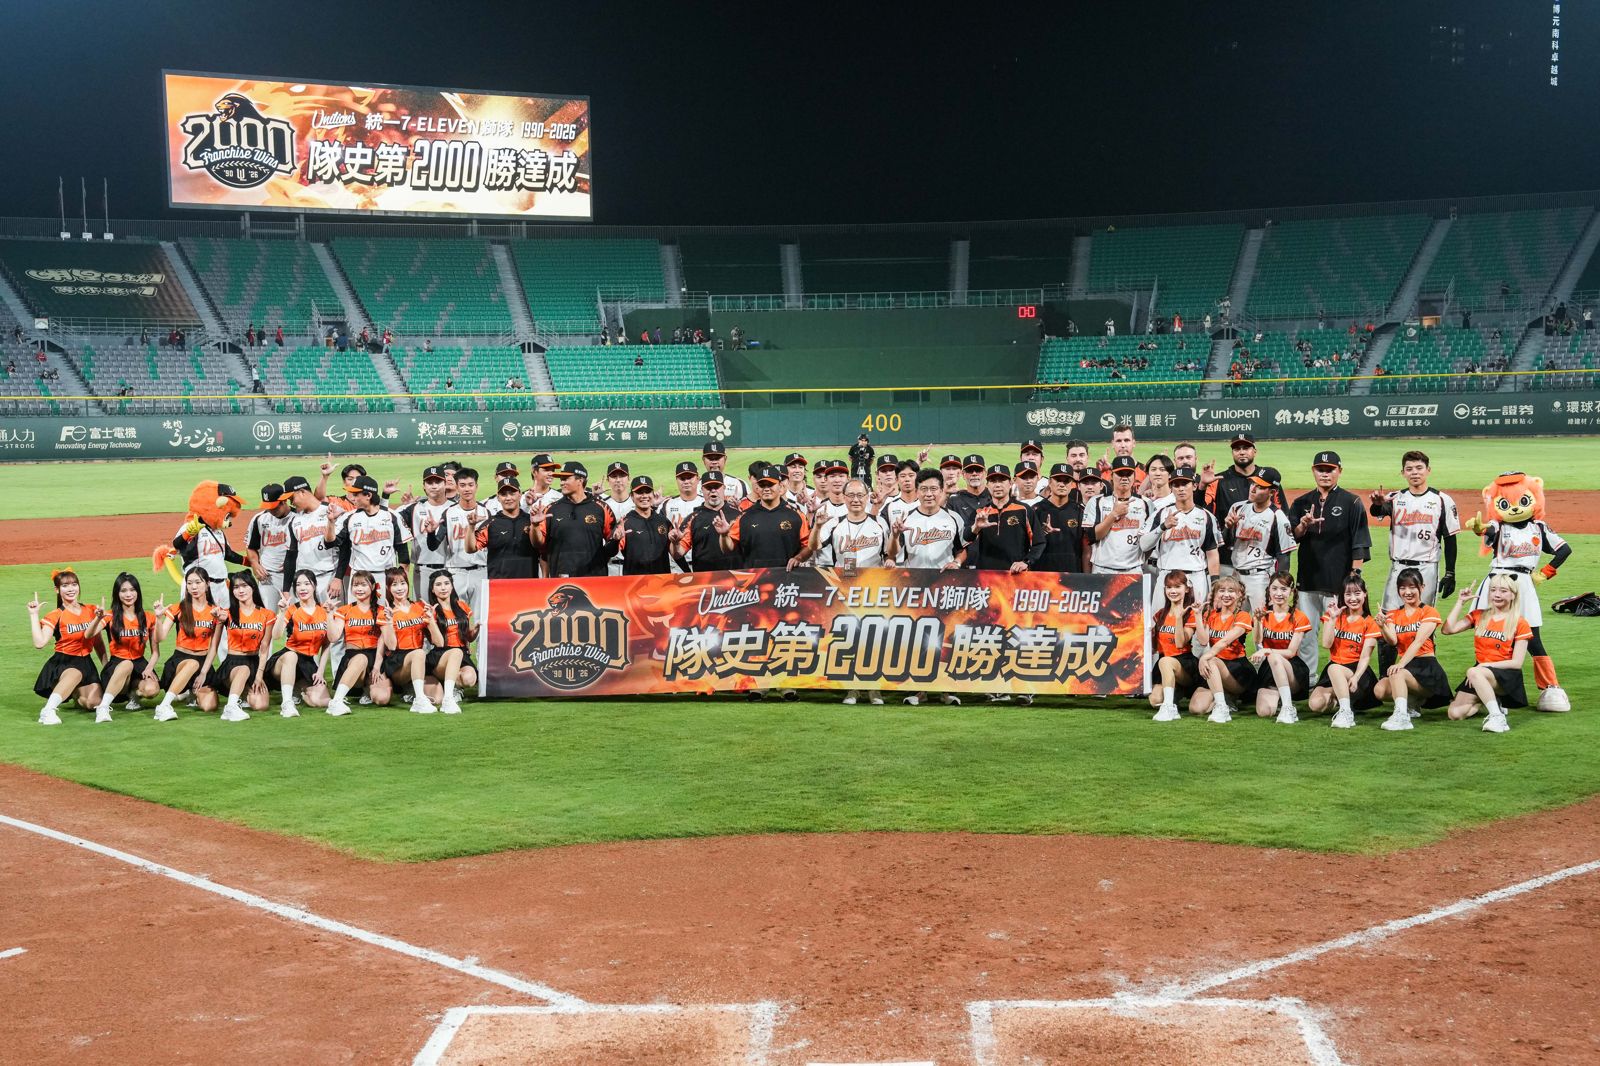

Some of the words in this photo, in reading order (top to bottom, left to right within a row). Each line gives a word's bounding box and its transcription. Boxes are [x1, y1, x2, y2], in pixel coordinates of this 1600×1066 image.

[521, 121, 577, 140] 1990-2026
[182, 115, 296, 173] 2000
[200, 147, 252, 165] Franchise
[253, 150, 279, 168] Wins
[309, 139, 579, 190] 隊史第2000勝達成
[1211, 407, 1260, 419] uniopen
[1472, 405, 1534, 416] 統一證券
[608, 420, 648, 429] KENDA
[861, 413, 902, 432] 400
[1121, 414, 1176, 427] 兆豐銀行
[90, 427, 137, 439] 富士電機
[278, 421, 302, 434] 輝葉
[351, 427, 398, 440] 全球人壽
[522, 425, 571, 437] 金門酒廠
[1198, 423, 1251, 432] 生活由我OPEN
[589, 432, 648, 441] 建大輪胎
[55, 442, 86, 450] Innovating
[88, 442, 108, 450] Energy
[110, 441, 142, 449] Technology
[1127, 535, 1138, 546] 82
[1417, 530, 1430, 541] 65
[380, 546, 391, 556] 67
[1248, 546, 1261, 558] 73
[697, 585, 761, 615] Unilions
[774, 583, 990, 612] 統一7-ELEVEN獅隊
[1012, 589, 1102, 614] 1990-2026
[511, 609, 631, 672] 2000
[529, 642, 583, 666] Franchise
[585, 644, 611, 665] Wins
[665, 615, 1115, 684] 隊史第2000勝達成
